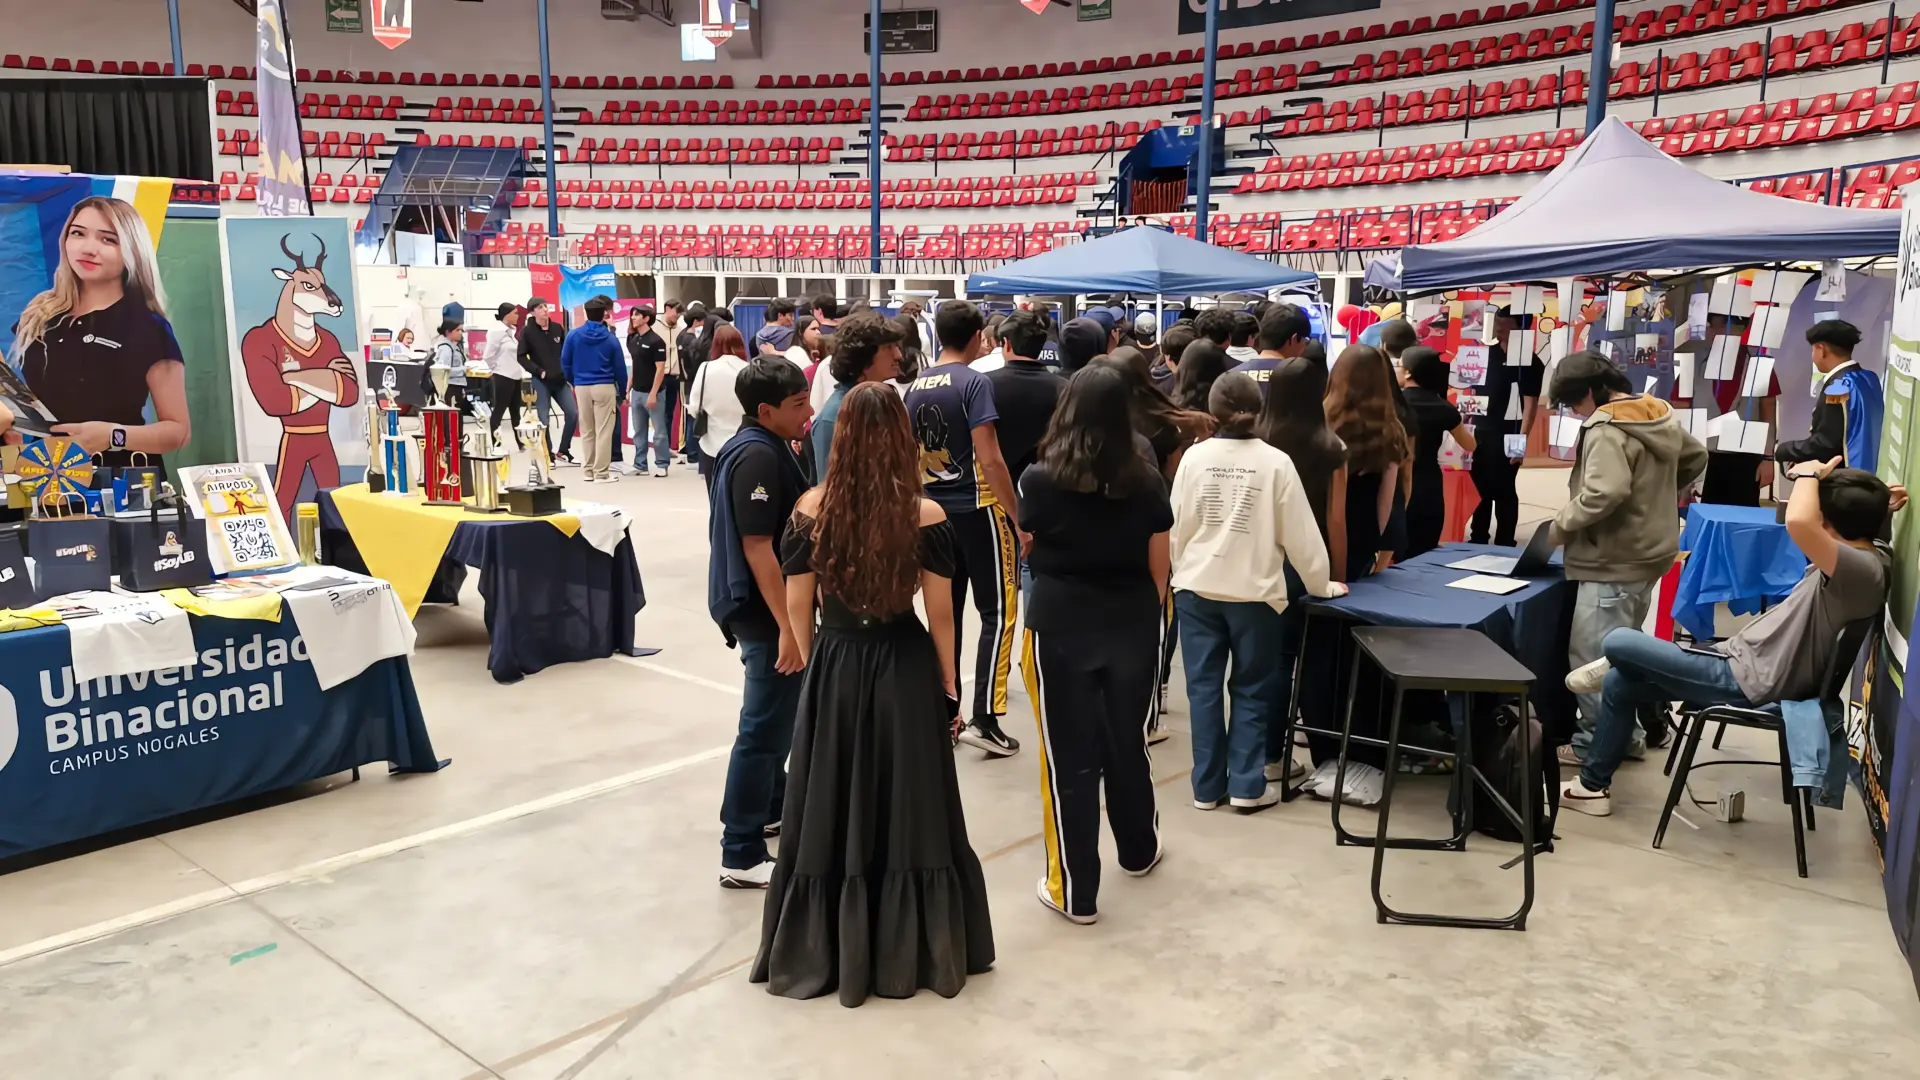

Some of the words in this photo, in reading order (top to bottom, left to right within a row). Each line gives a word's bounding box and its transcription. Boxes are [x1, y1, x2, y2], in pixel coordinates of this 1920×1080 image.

[44, 671, 284, 753] Binacional
[49, 745, 129, 775] CAMPUS
[137, 726, 220, 757] NOGALES
